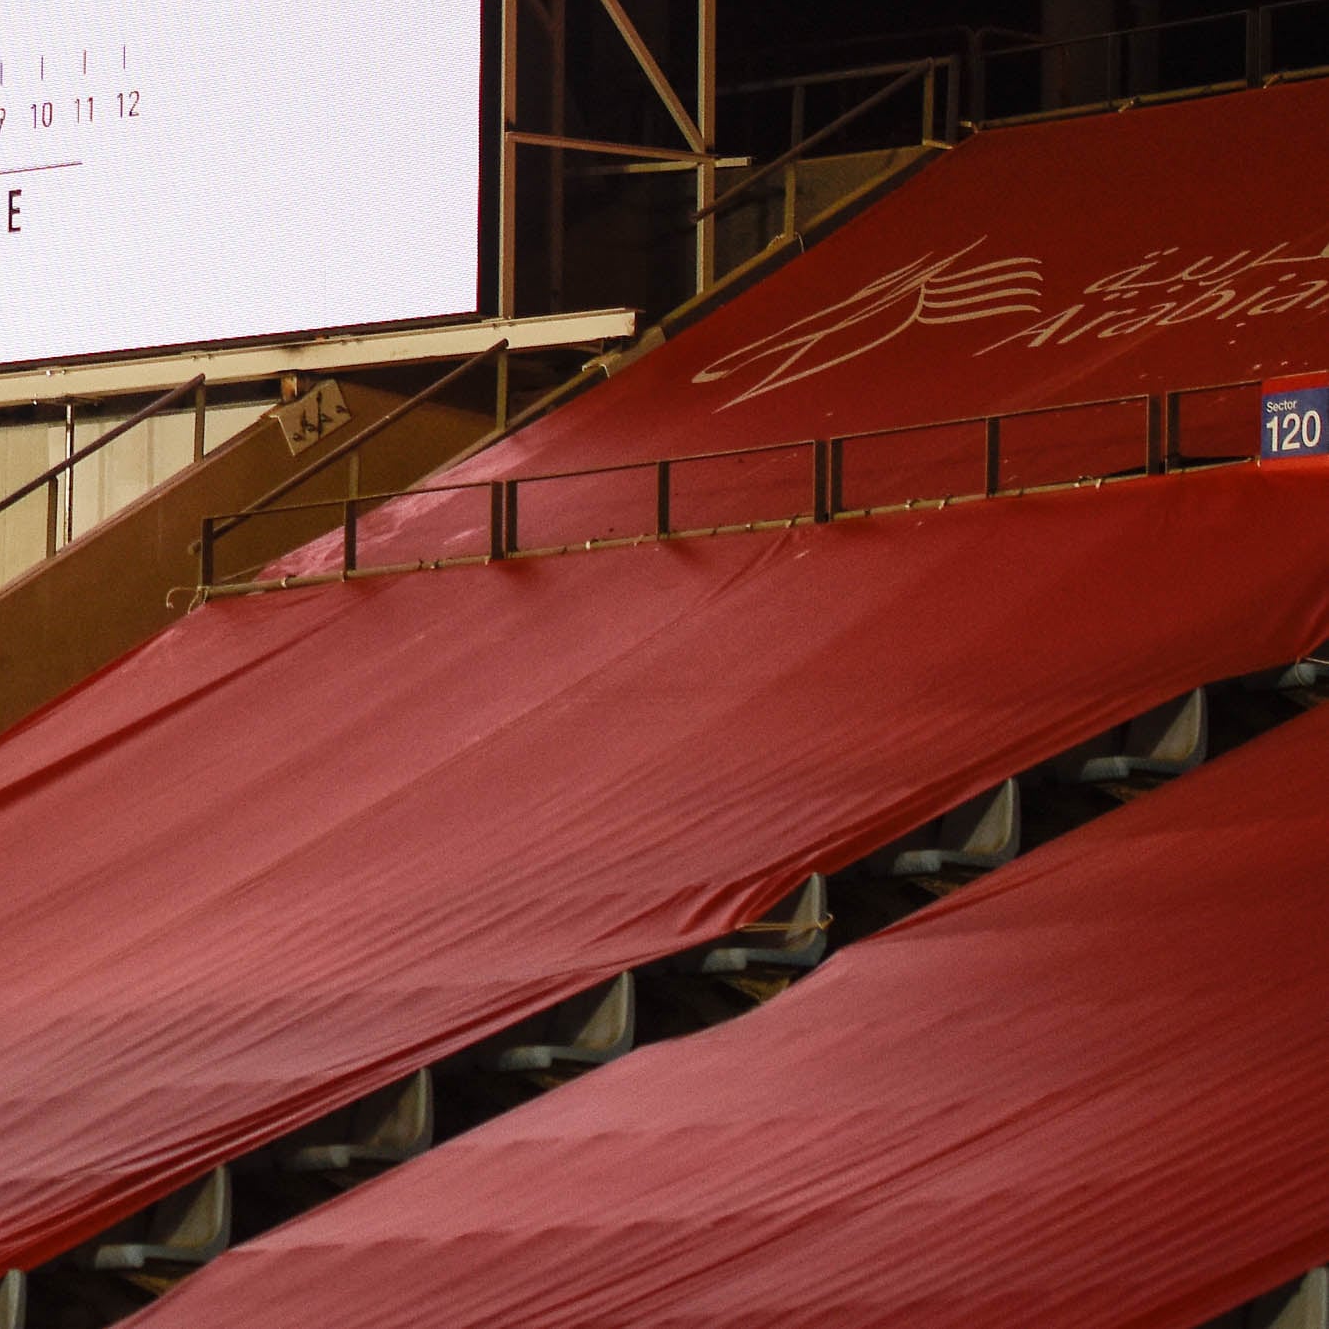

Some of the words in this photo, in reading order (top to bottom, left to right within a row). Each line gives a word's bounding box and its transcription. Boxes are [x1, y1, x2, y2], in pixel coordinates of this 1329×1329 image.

[30, 101, 53, 129] 10
[74, 96, 94, 123] 11
[117, 90, 140, 118] 12
[1266, 399, 1298, 413] Sector
[1266, 410, 1321, 453] 120
